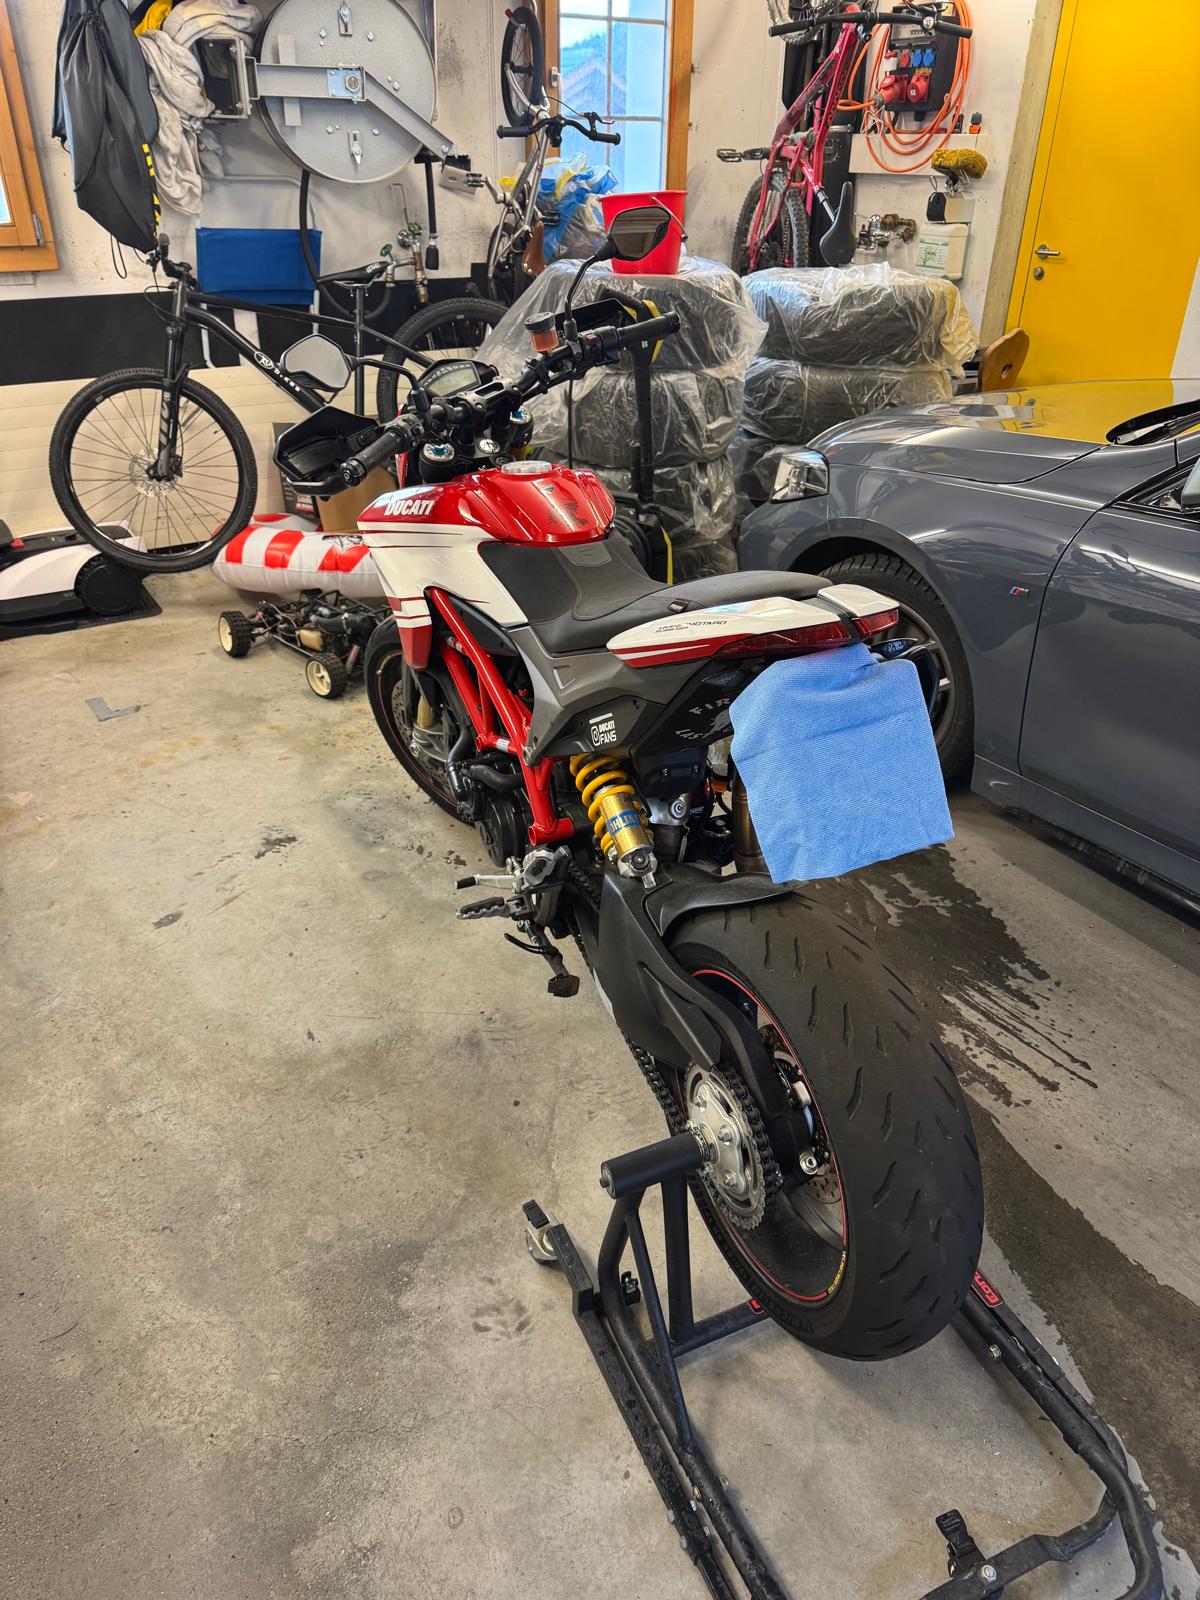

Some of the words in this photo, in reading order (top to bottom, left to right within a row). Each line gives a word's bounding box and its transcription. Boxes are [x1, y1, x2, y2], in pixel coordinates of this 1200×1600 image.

[384, 499, 435, 516] DUCATI
[599, 720, 616, 733] DUCATI
[600, 730, 617, 745] FANS
